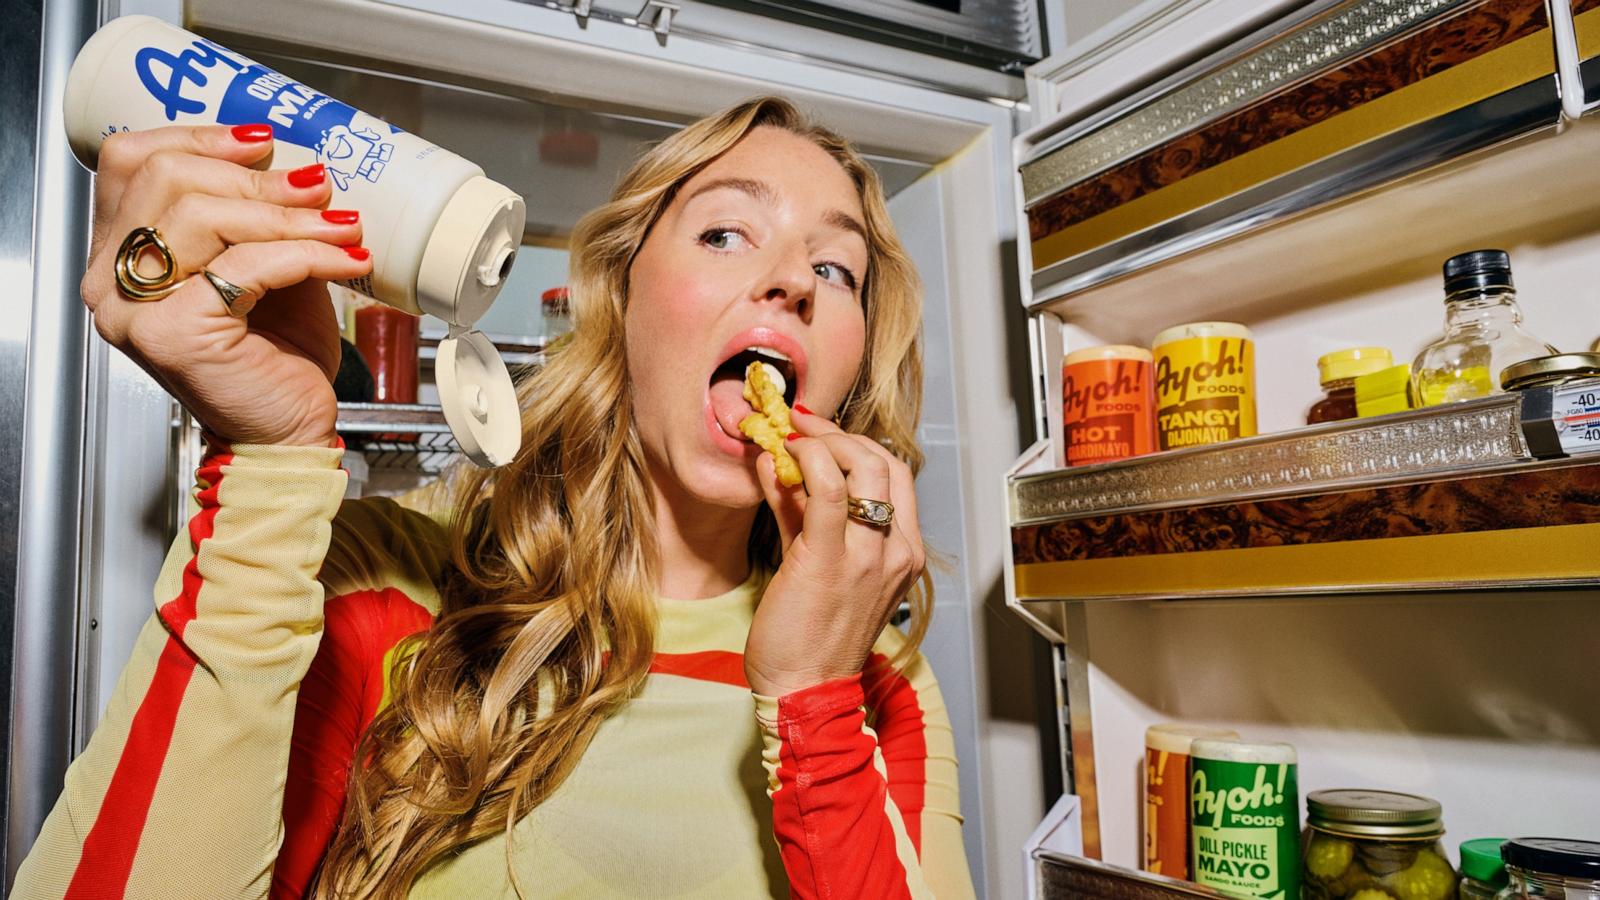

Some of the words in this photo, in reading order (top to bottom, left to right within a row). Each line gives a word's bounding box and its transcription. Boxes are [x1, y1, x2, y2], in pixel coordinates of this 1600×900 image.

[135, 39, 249, 121] Ay
[247, 71, 296, 101] ORIG
[267, 84, 321, 128] MA
[1157, 338, 1246, 402] Ayoh!
[1063, 361, 1144, 419] Ayoh!
[1197, 385, 1246, 394] FOODS
[1096, 403, 1141, 412] FOODS
[1159, 409, 1239, 431] TANGY
[1072, 426, 1121, 444] HOT
[1168, 427, 1229, 447] DIJONAYO
[1192, 764, 1288, 828] Ayoh!
[1231, 814, 1284, 827] FOODS
[1199, 836, 1219, 855] DILL
[1222, 841, 1267, 860] PICKLE
[1199, 854, 1270, 880] MAYO
[1232, 881, 1260, 889] SAUCE
